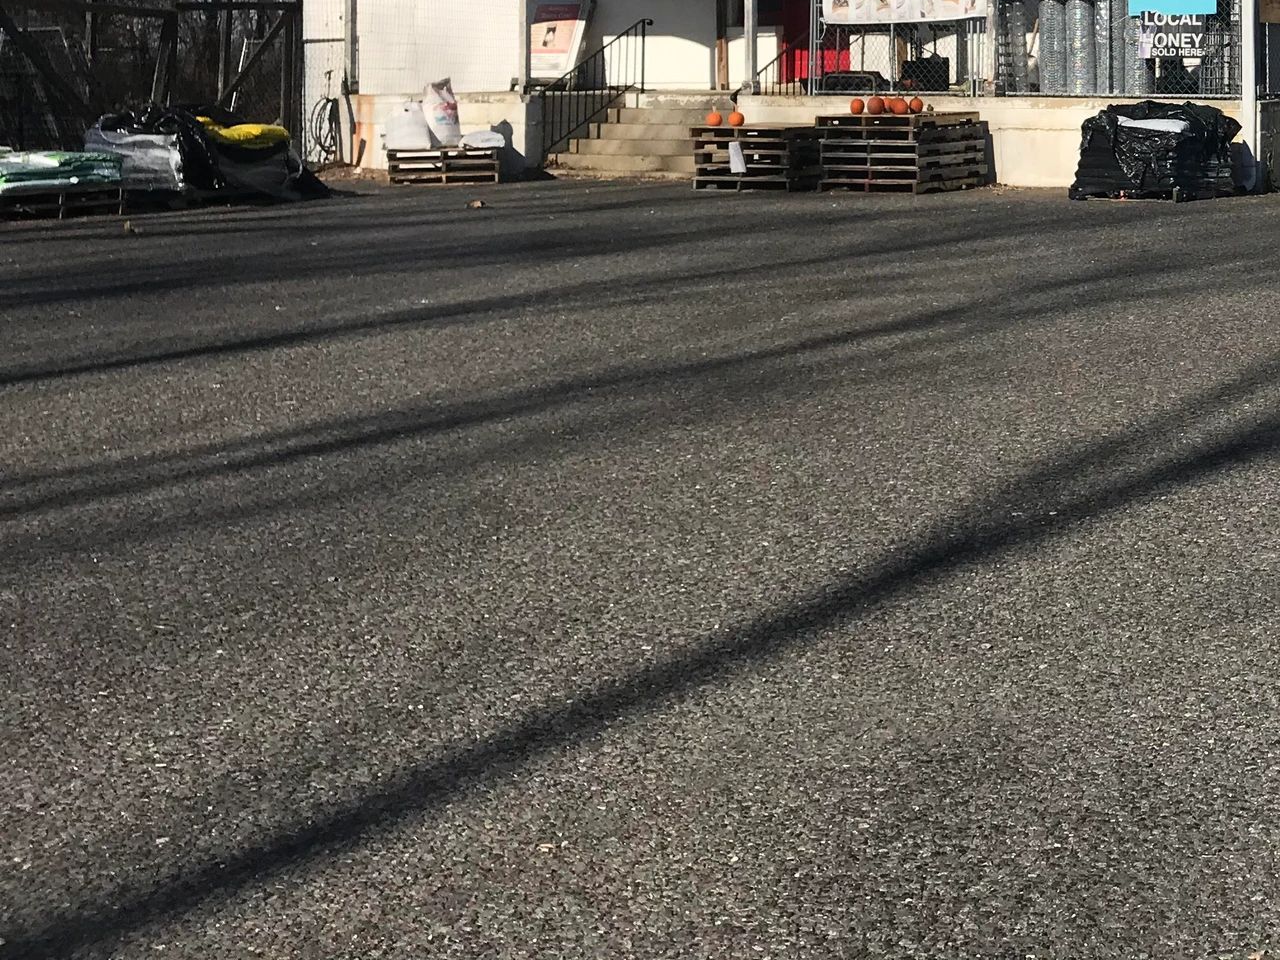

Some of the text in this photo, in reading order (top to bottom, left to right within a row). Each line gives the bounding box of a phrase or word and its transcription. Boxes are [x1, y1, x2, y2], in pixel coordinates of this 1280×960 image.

[1144, 11, 1202, 26] LOCAL
[1151, 47, 1203, 56] SOLD HERE
